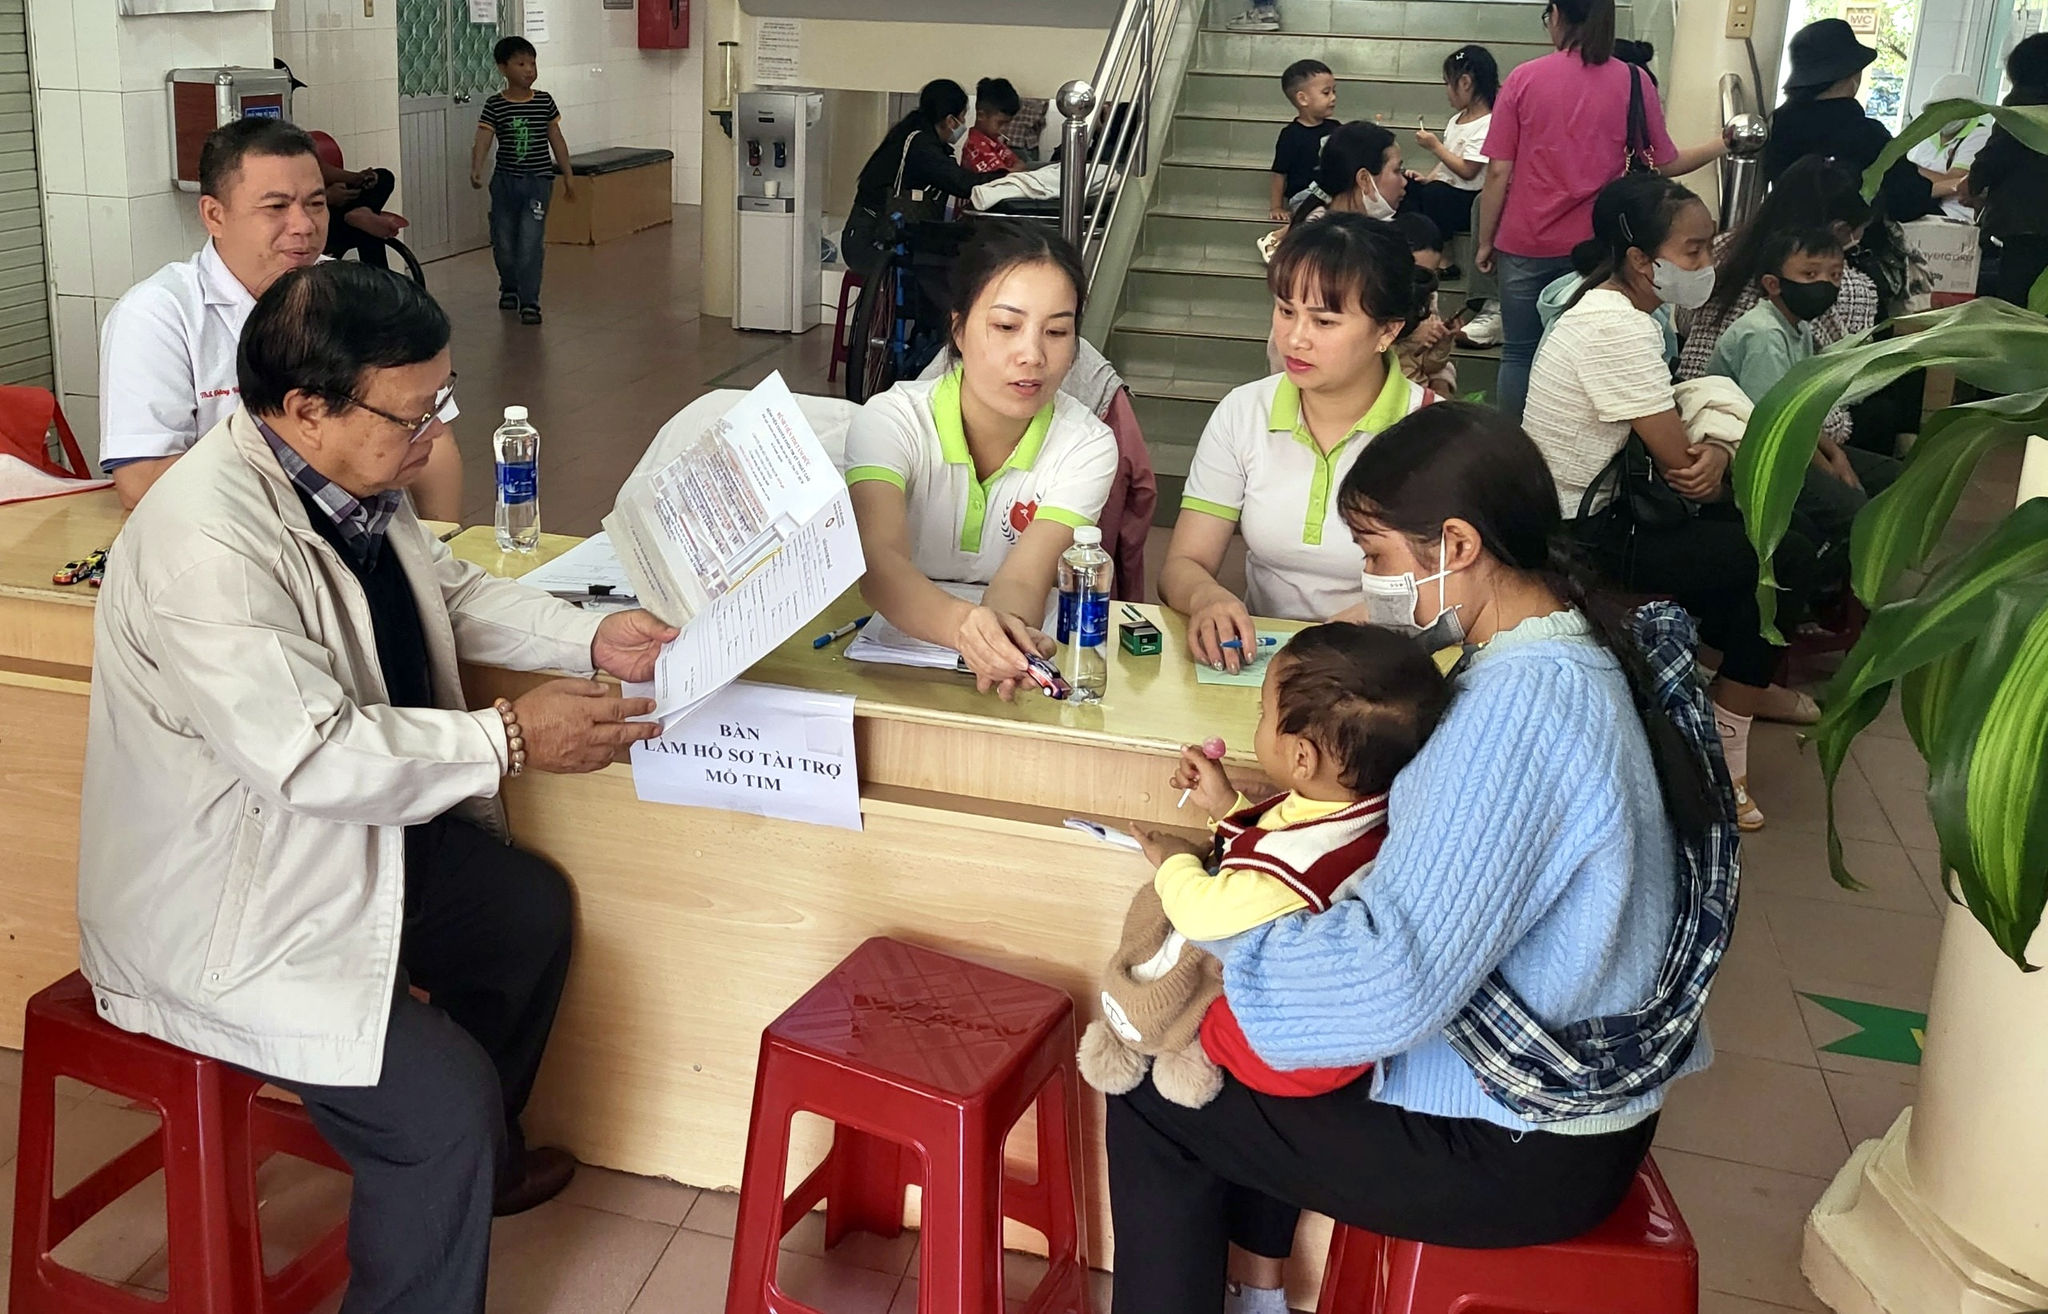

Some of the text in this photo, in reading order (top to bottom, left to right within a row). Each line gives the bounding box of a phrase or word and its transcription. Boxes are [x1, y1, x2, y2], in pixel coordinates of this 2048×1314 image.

[1850, 15, 1872, 25] WC
[720, 722, 760, 741] BÀN
[643, 736, 842, 780] LÀM HỒ SƠ TÀI TRỢ
[742, 773, 782, 792] TIM
